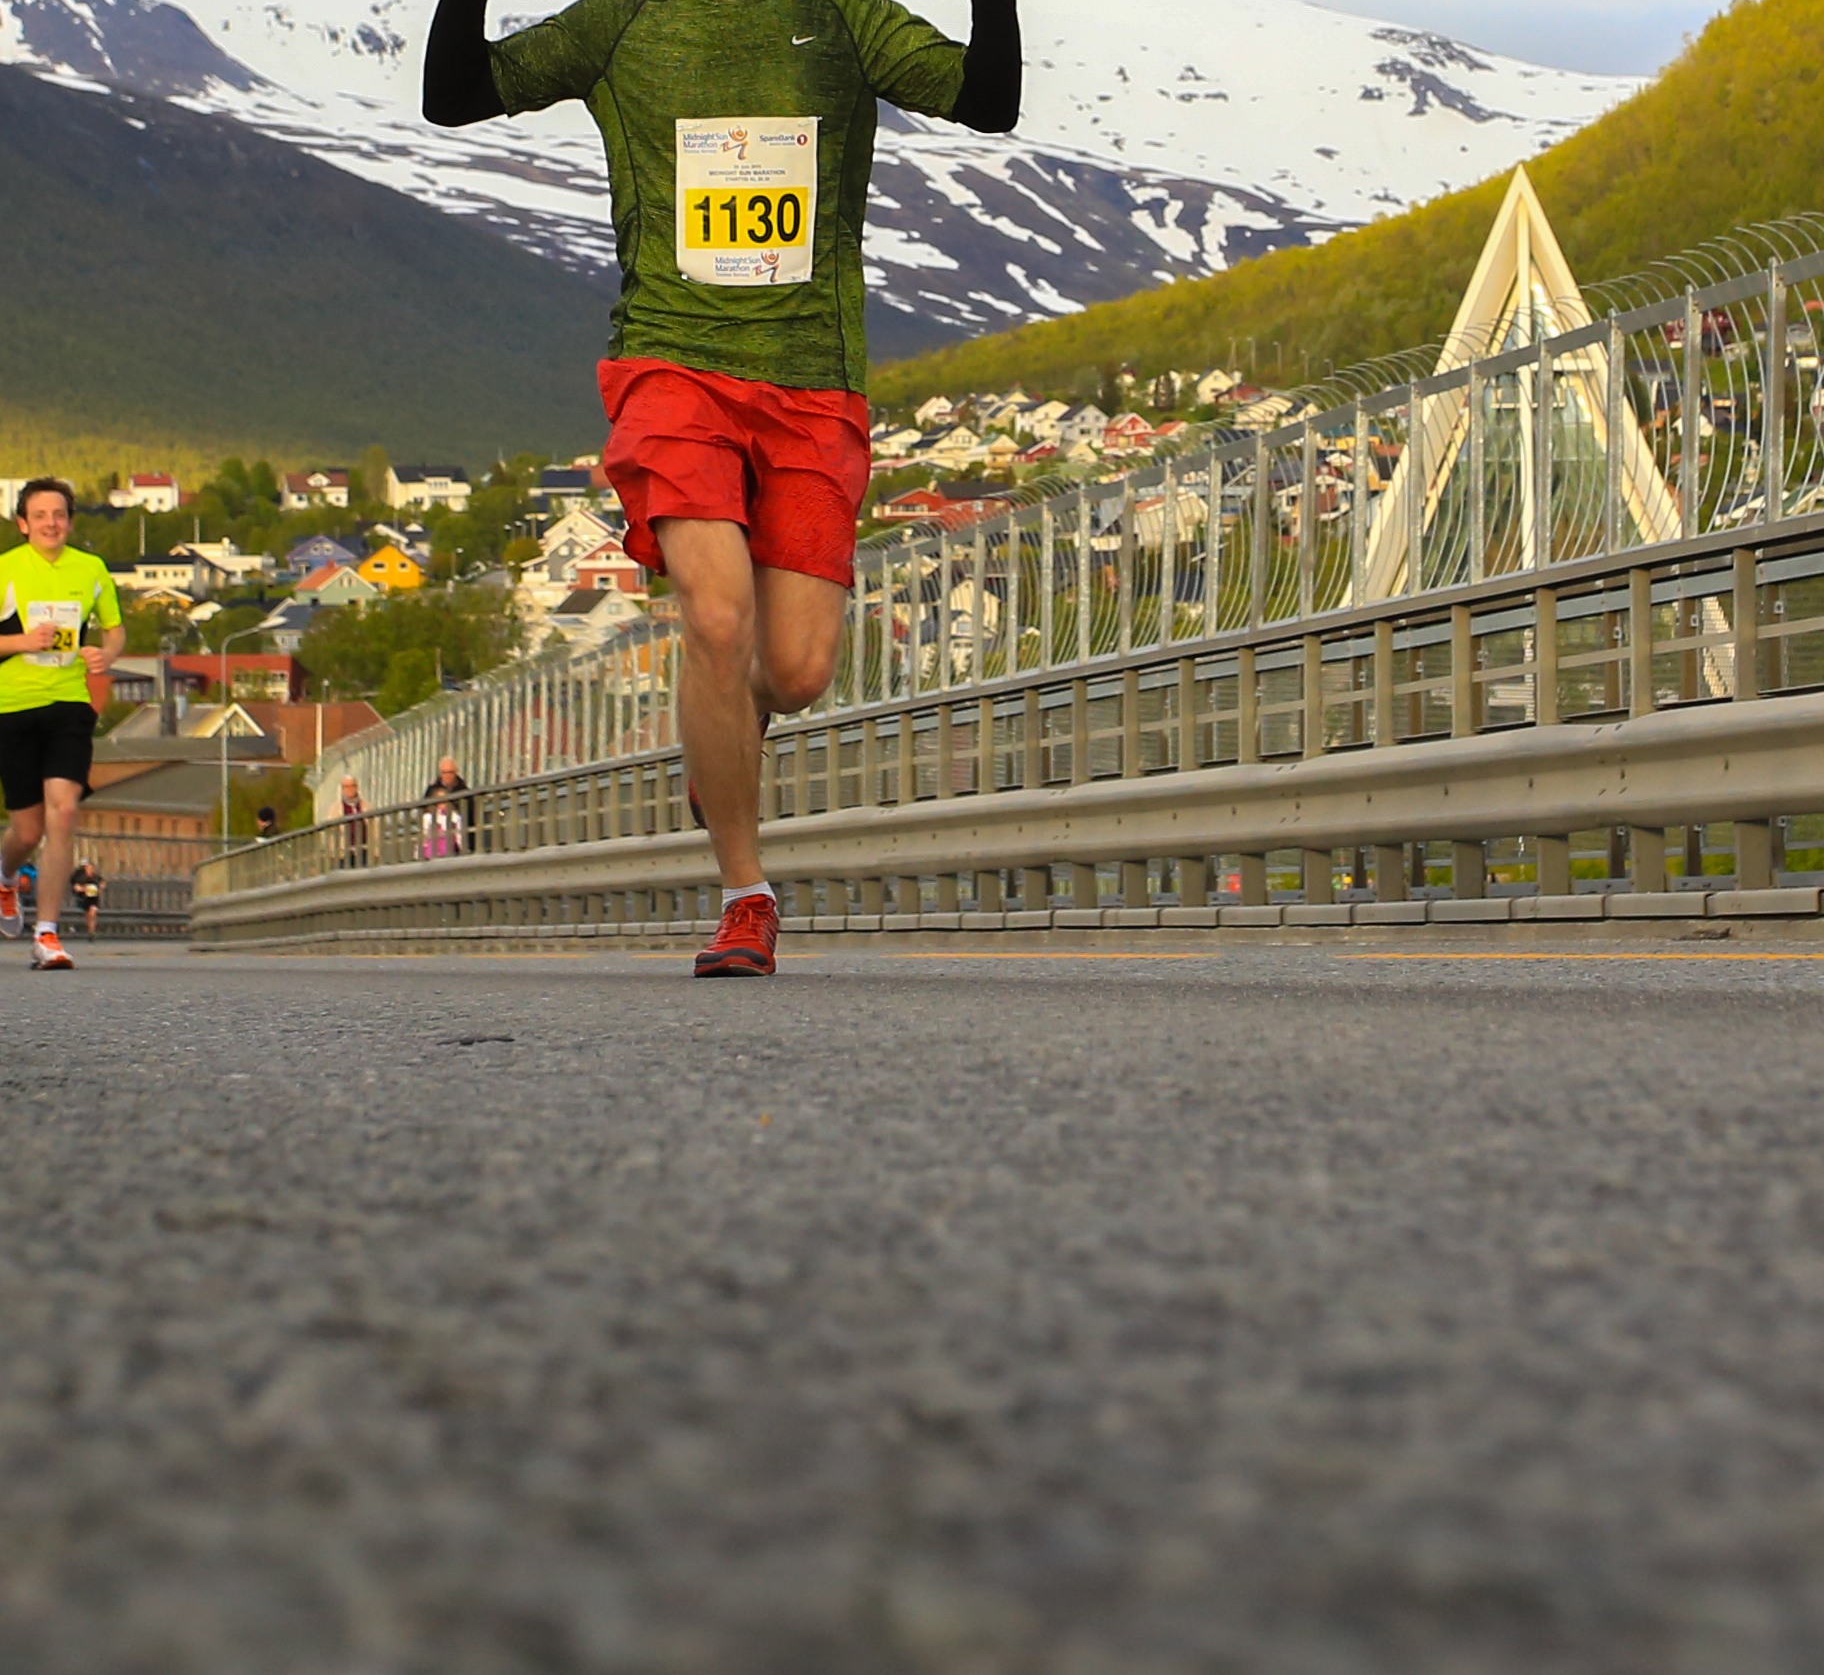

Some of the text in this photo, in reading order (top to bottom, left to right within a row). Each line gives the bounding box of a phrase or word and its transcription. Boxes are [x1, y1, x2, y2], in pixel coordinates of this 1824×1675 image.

[694, 193, 800, 243] 1130
[715, 256, 761, 266] Midnight Sun
[52, 631, 73, 650] 24
